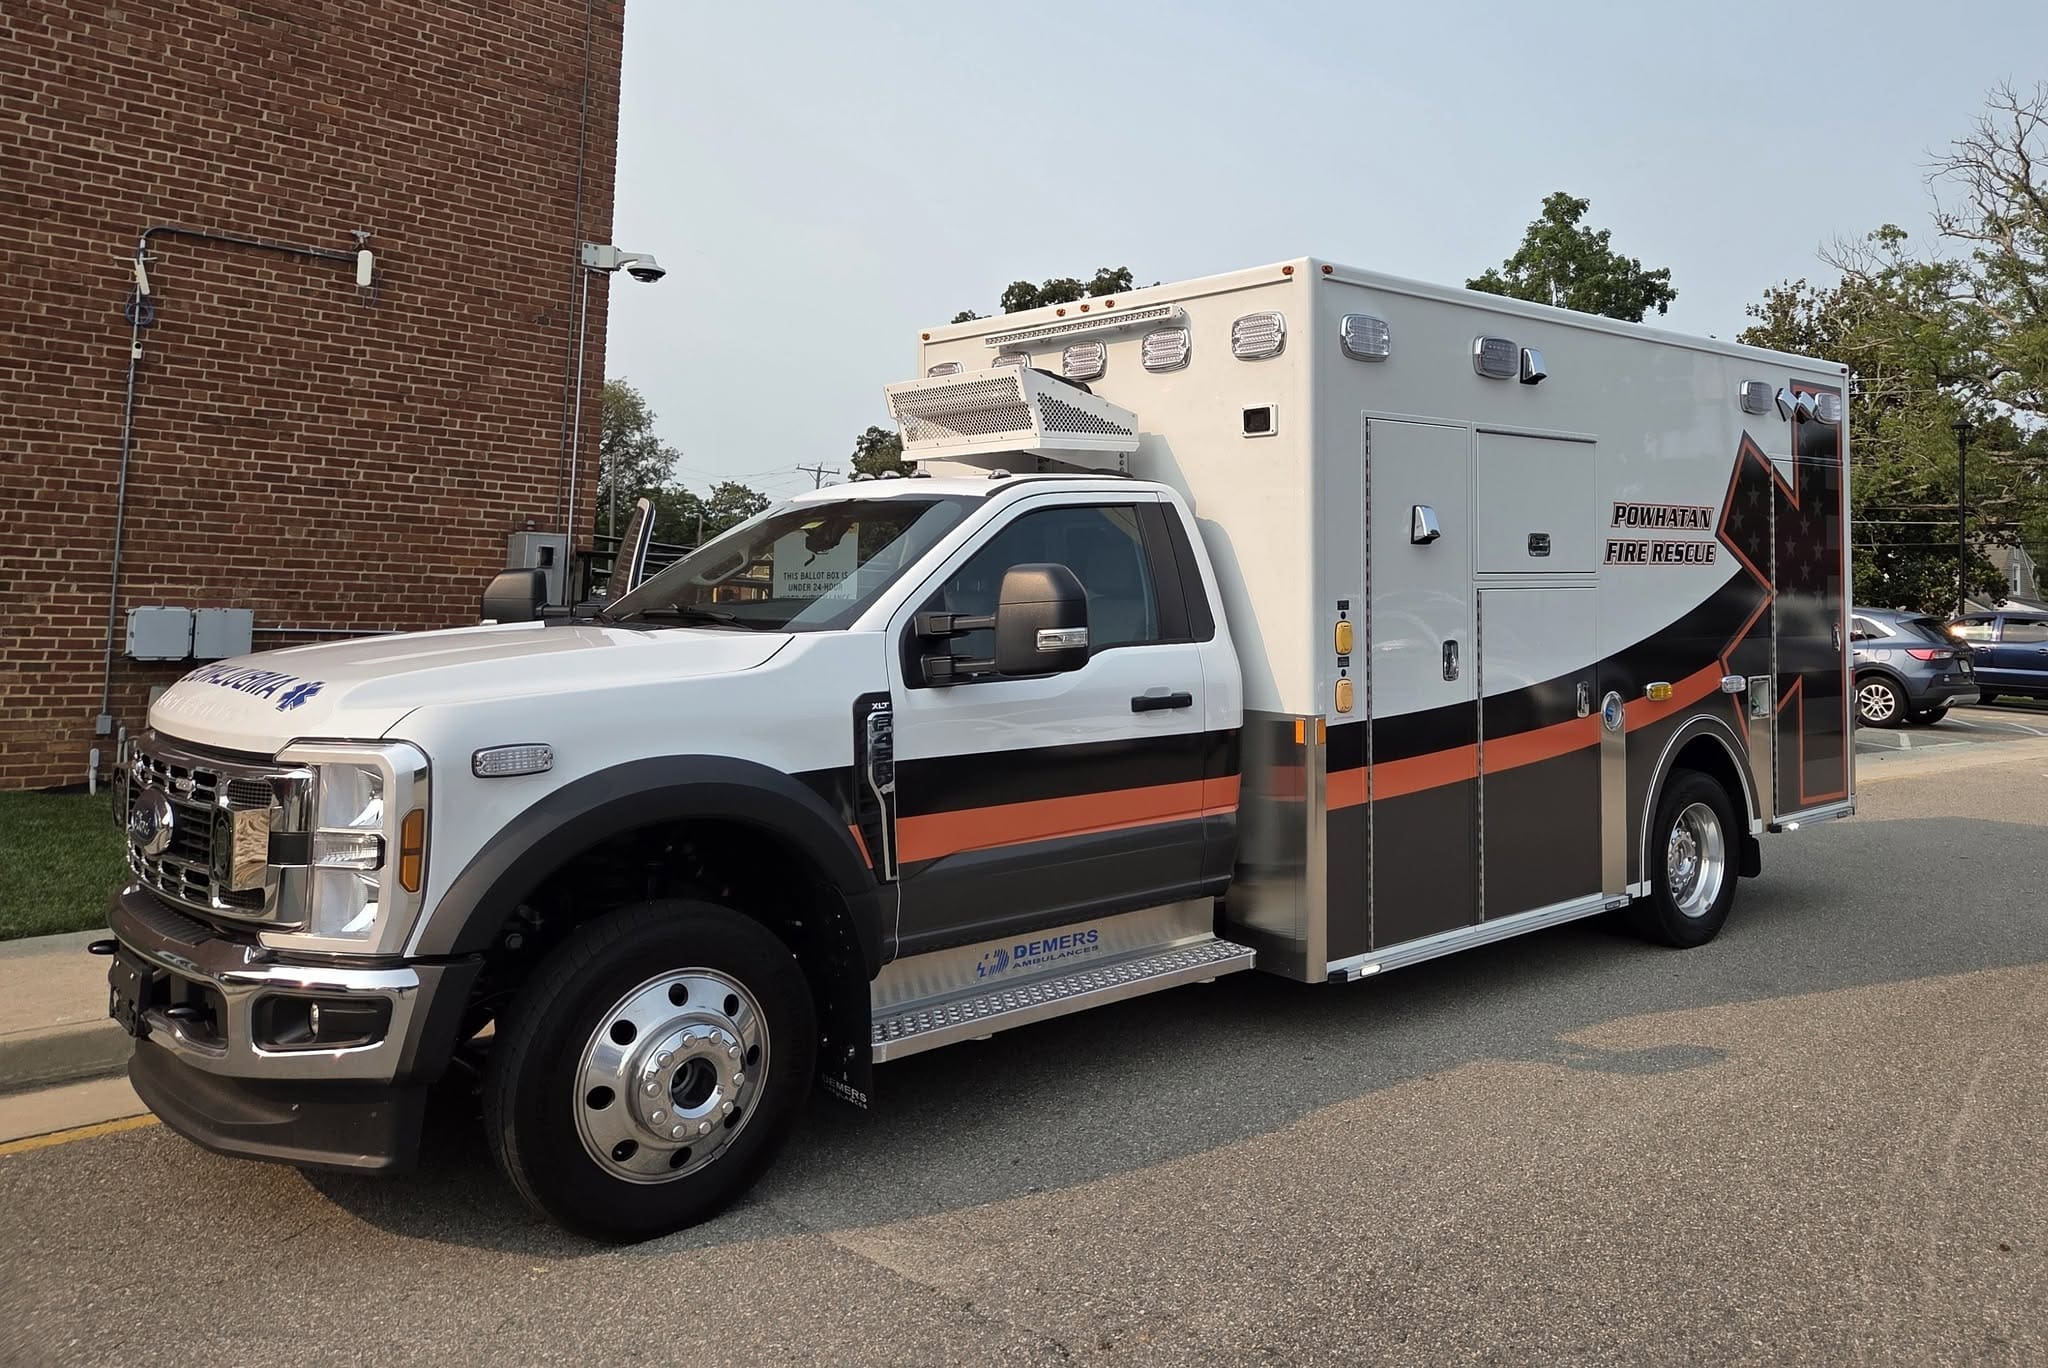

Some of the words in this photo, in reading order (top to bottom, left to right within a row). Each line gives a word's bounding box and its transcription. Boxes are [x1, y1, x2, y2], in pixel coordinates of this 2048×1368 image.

[1612, 503, 1714, 530] POWHATAN
[1604, 540, 1648, 565] FIRE
[1649, 540, 1716, 565] RESCUE
[783, 572, 798, 581] THIS
[800, 571, 824, 580] BALLOT
[826, 571, 840, 580] BOX
[841, 571, 849, 580] IS
[788, 583, 811, 592] UNDER
[871, 702, 890, 710] XLT
[1013, 929, 1099, 960] DEMERS
[1012, 945, 1099, 969] AMBULANCES
